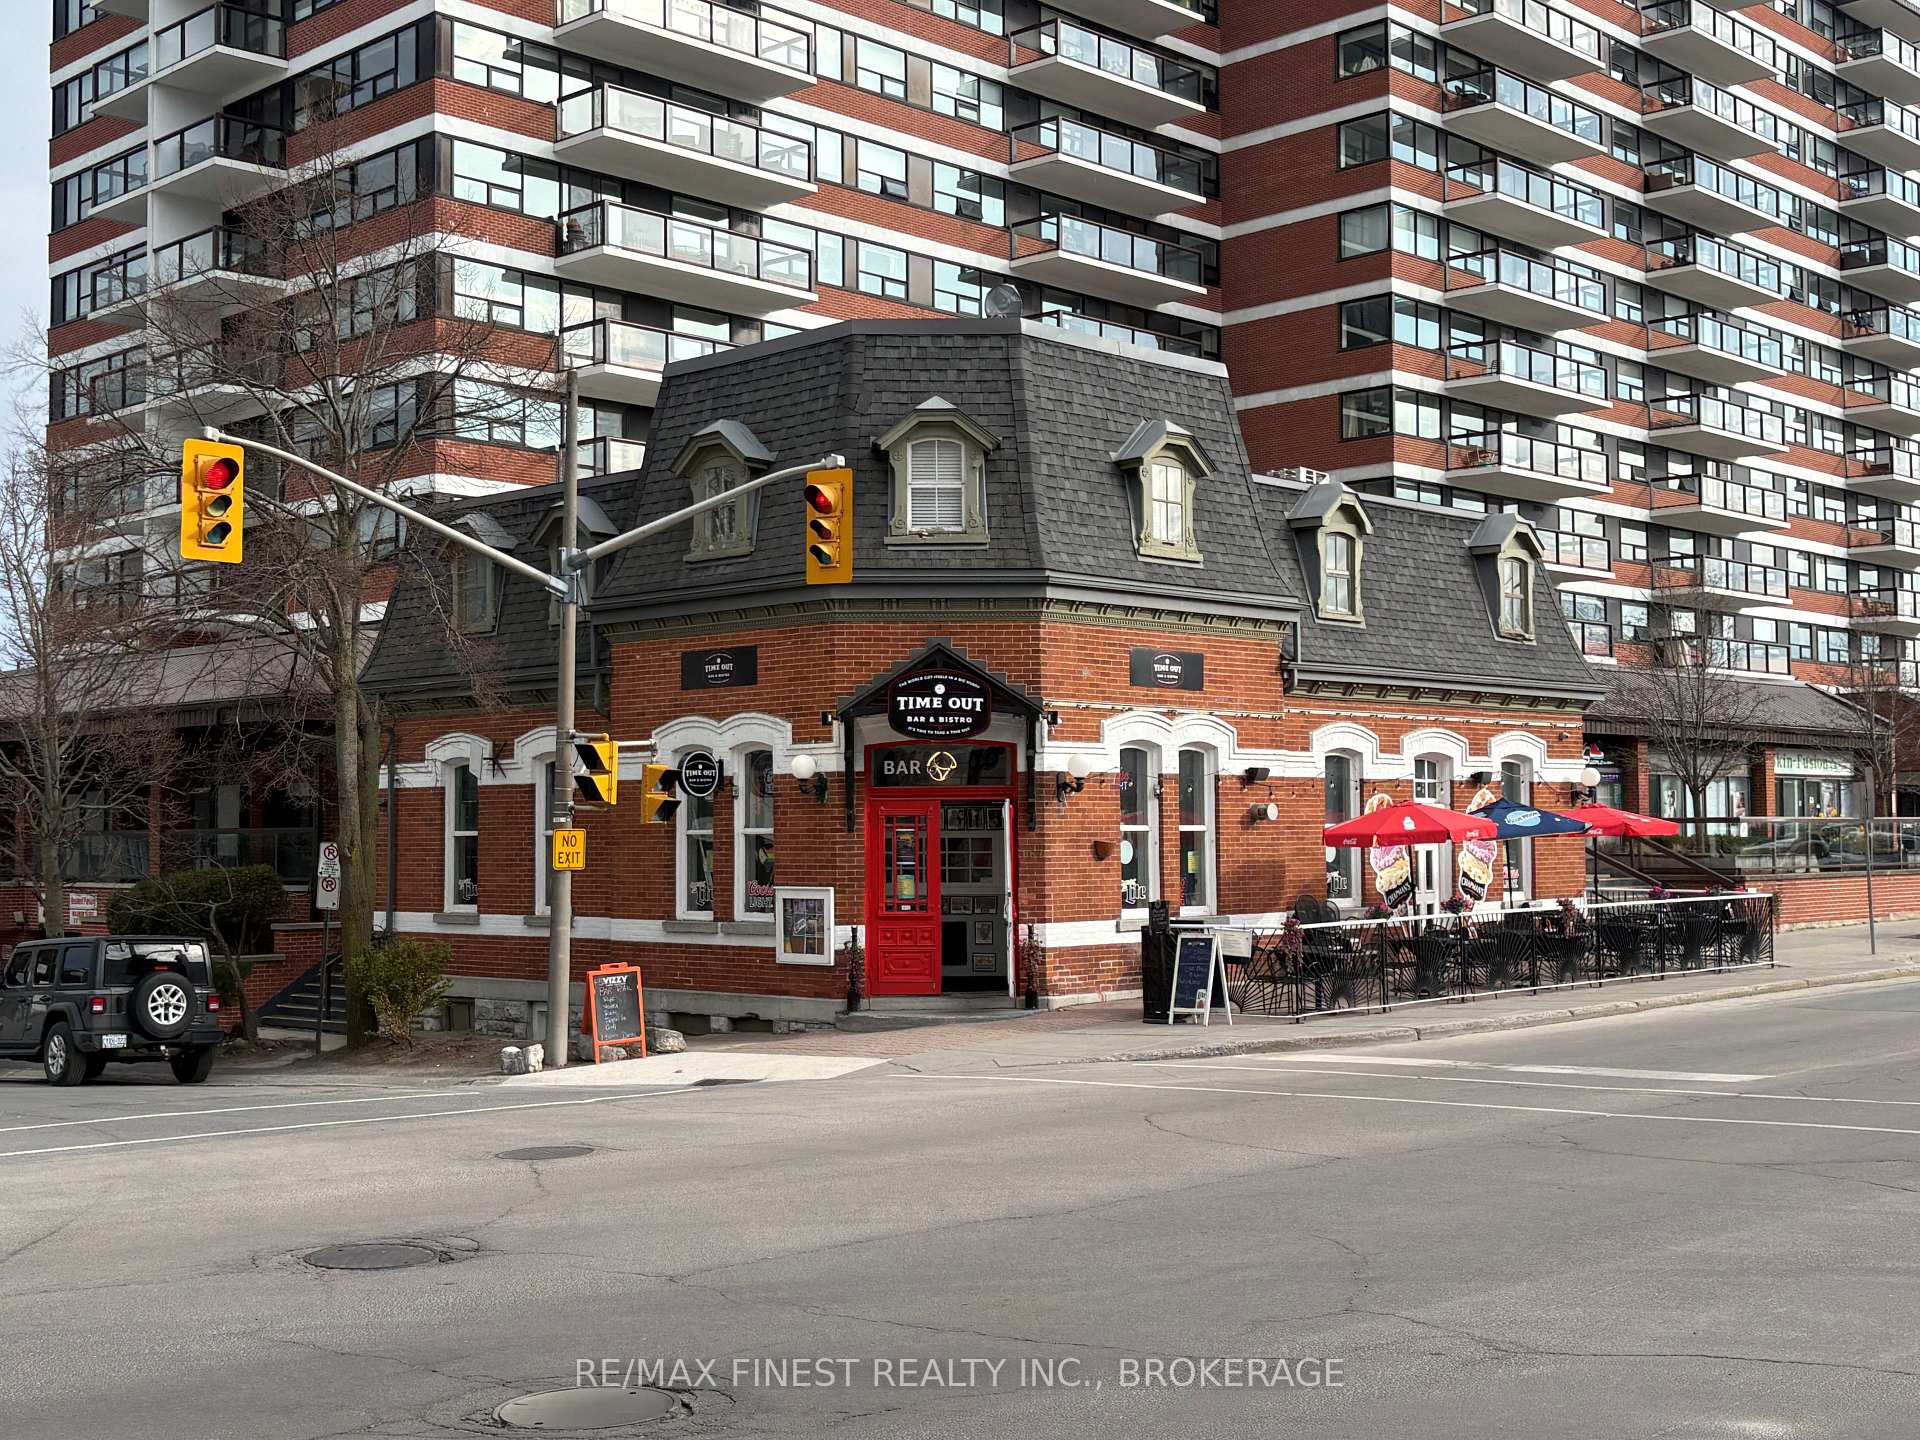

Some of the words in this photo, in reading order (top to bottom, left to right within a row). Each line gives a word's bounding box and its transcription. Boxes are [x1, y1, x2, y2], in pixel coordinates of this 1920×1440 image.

[705, 664, 720, 672] TIME
[721, 663, 734, 671] OUT
[1153, 664, 1169, 672] TIME
[1169, 665, 1182, 673] OUT
[907, 676, 923, 684] WORLD
[896, 696, 943, 710] TIME
[948, 697, 984, 712] OUT
[685, 769, 702, 777] TIME
[703, 769, 716, 777] OUT
[883, 760, 921, 775] BAR
[562, 834, 577, 847] NO
[558, 851, 581, 864] EXIT
[747, 880, 774, 896] Coors
[603, 975, 628, 984] VIZZY
